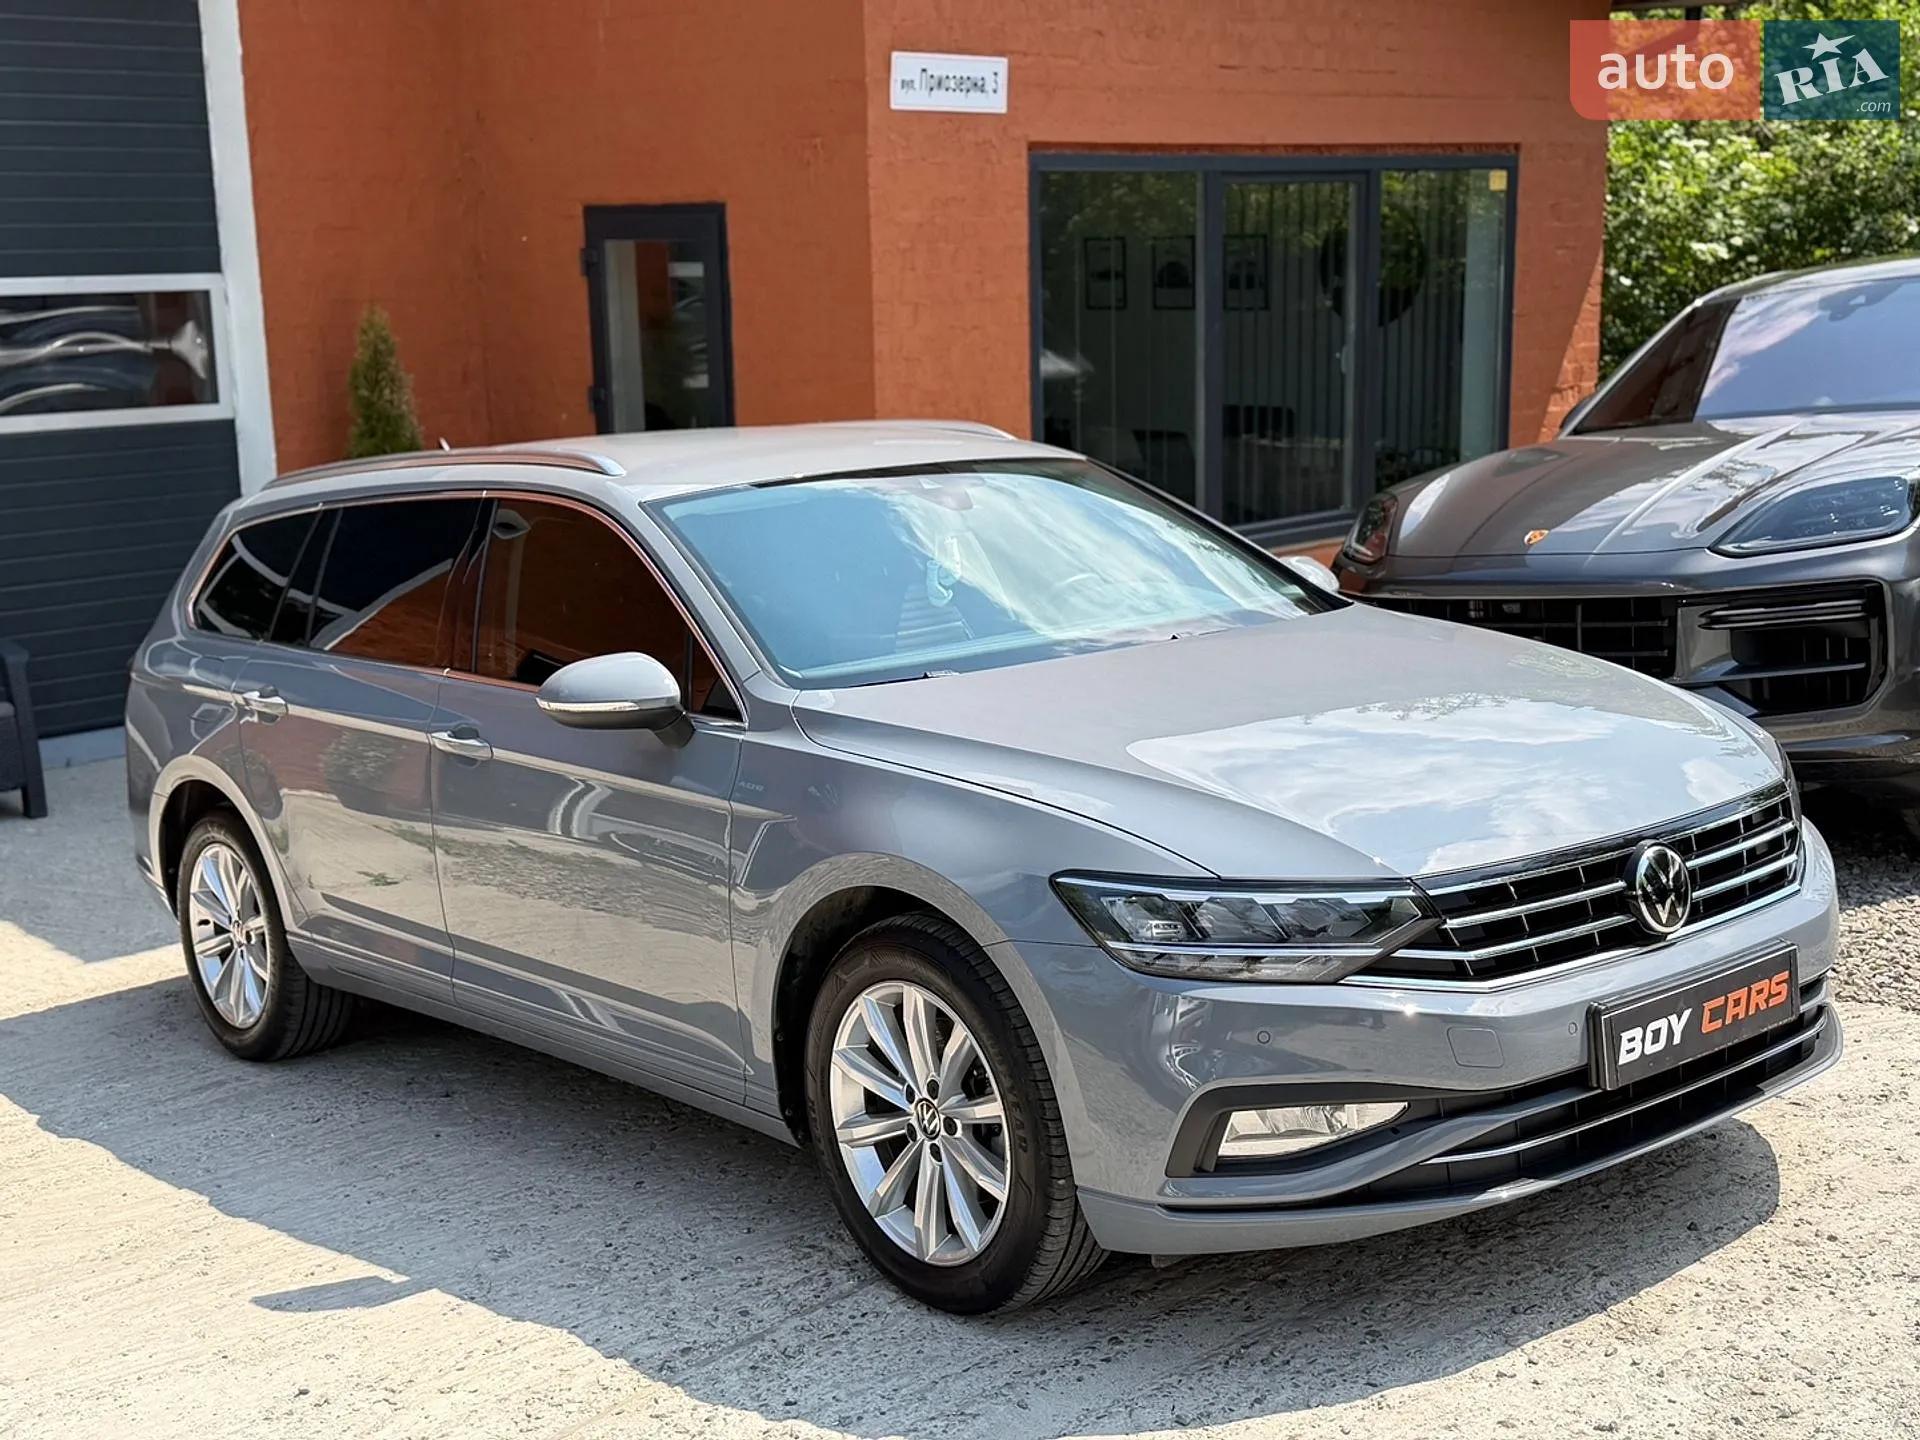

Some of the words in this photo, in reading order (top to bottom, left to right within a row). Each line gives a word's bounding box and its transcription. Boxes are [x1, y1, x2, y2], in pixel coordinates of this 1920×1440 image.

[920, 68, 989, 99] Приозерна,
[992, 71, 999, 95] 3
[1618, 1007, 1693, 1066] BOY
[1701, 970, 1790, 1035] CARS
